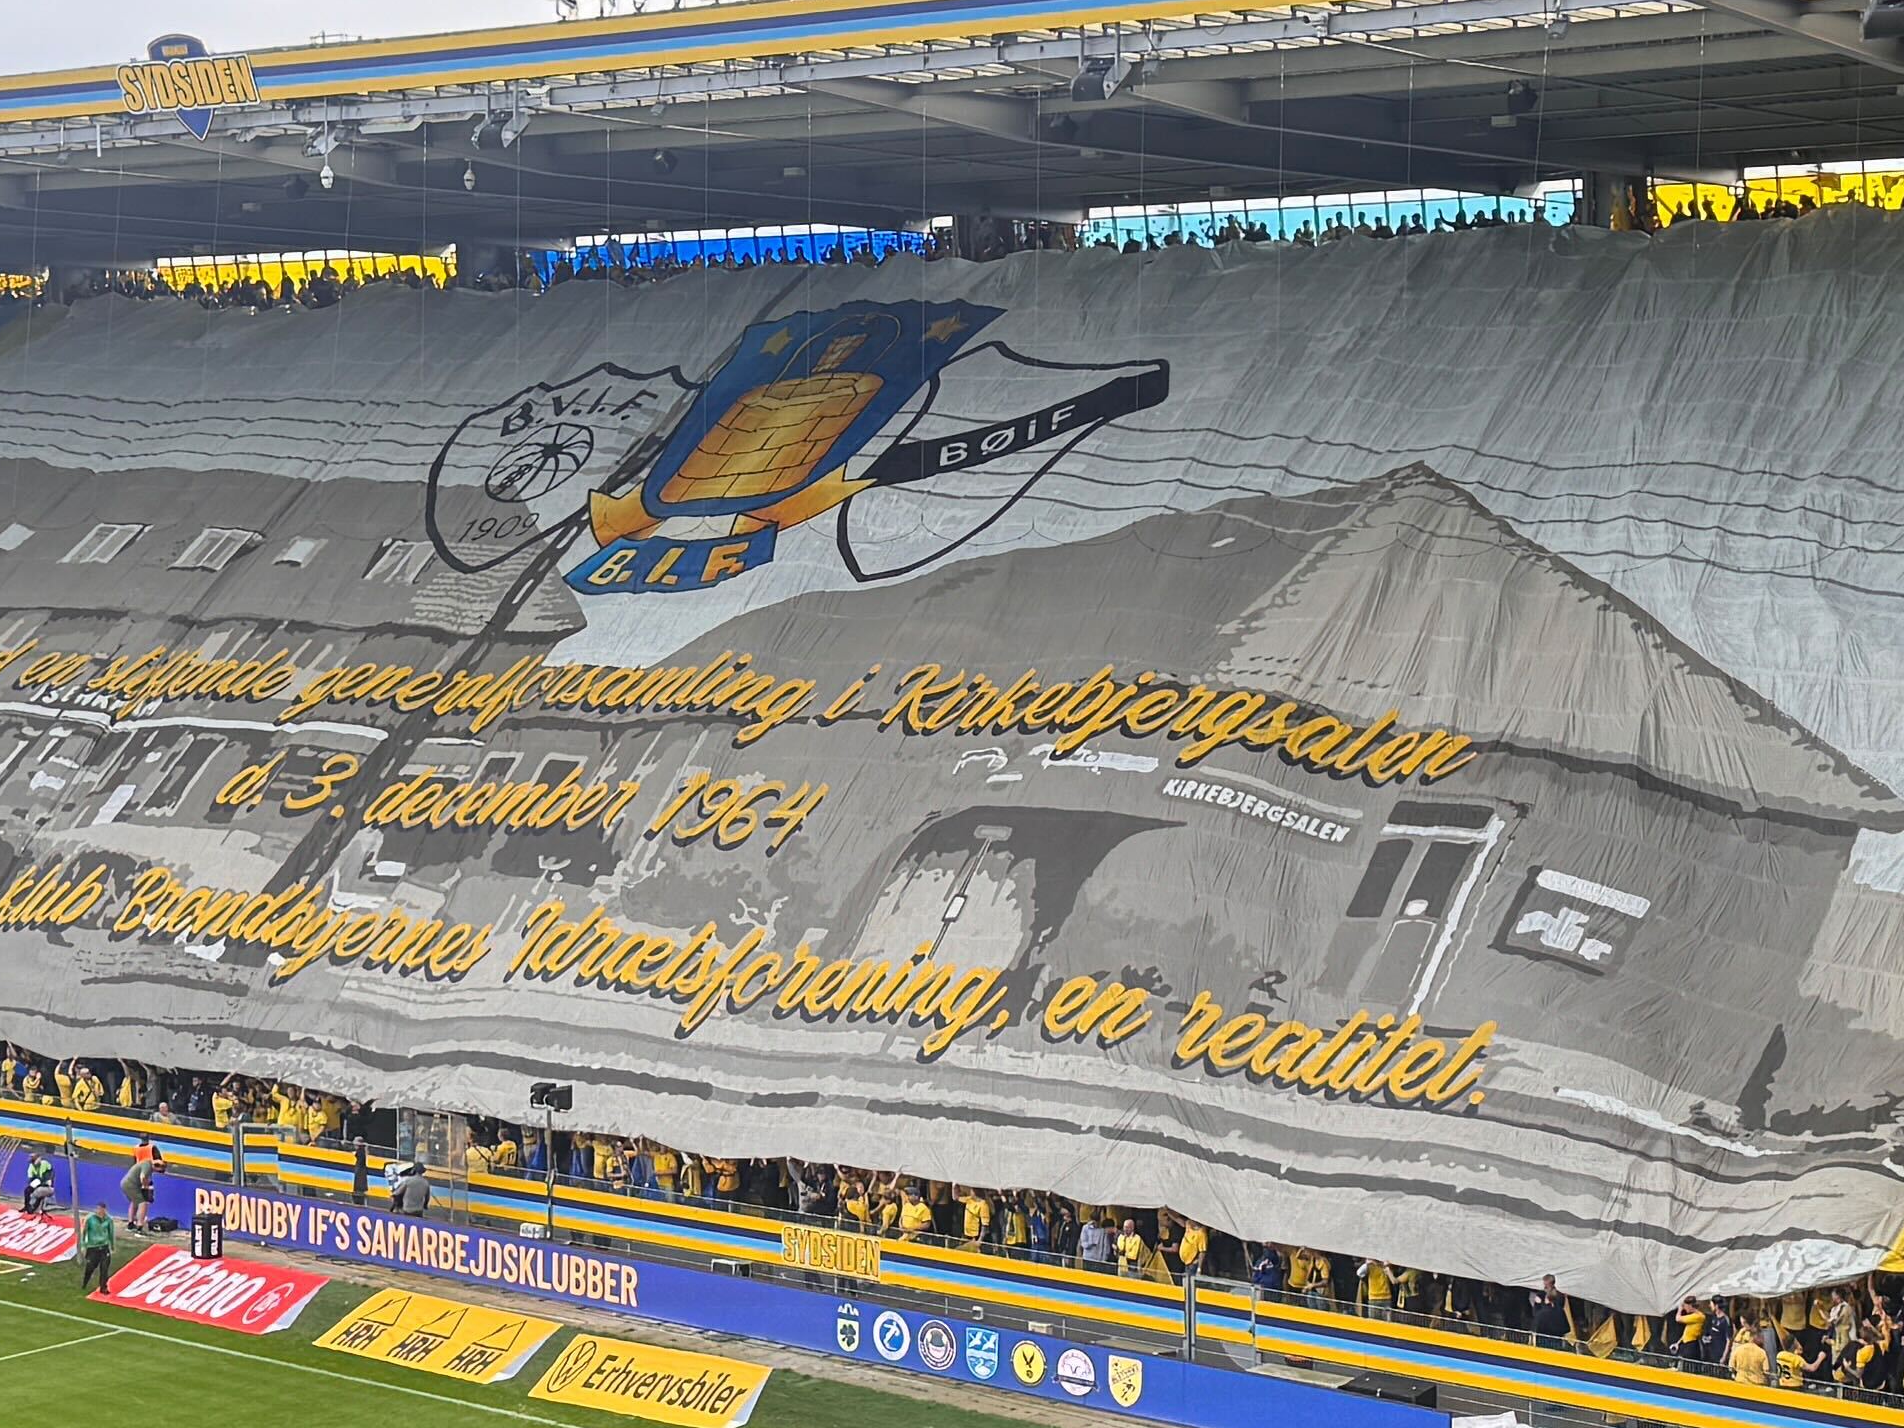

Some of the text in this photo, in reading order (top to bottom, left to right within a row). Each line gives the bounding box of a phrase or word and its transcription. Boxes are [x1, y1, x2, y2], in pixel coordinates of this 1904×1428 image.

[118, 56, 258, 112] SYDSIDEN
[458, 512, 539, 543] 1909
[19, 651, 92, 688] en
[280, 652, 834, 747] generalforsamling
[826, 664, 881, 720] i
[885, 662, 1478, 780] Kirkebjergsalen
[363, 768, 646, 831] december
[651, 767, 828, 850] 1964
[1042, 971, 1153, 1045] en
[1176, 987, 1499, 1110] realitet.
[308, 1207, 351, 1251] IF'S
[357, 1216, 638, 1308] SAMARBEJDSKLUBBER
[782, 1227, 880, 1278] SYDSIDEN
[118, 1255, 266, 1320] Betano
[330, 1320, 386, 1348] HRH
[386, 1332, 443, 1362] HRH
[444, 1345, 500, 1375] HRH
[581, 1354, 749, 1414] Erhvervsbiler
